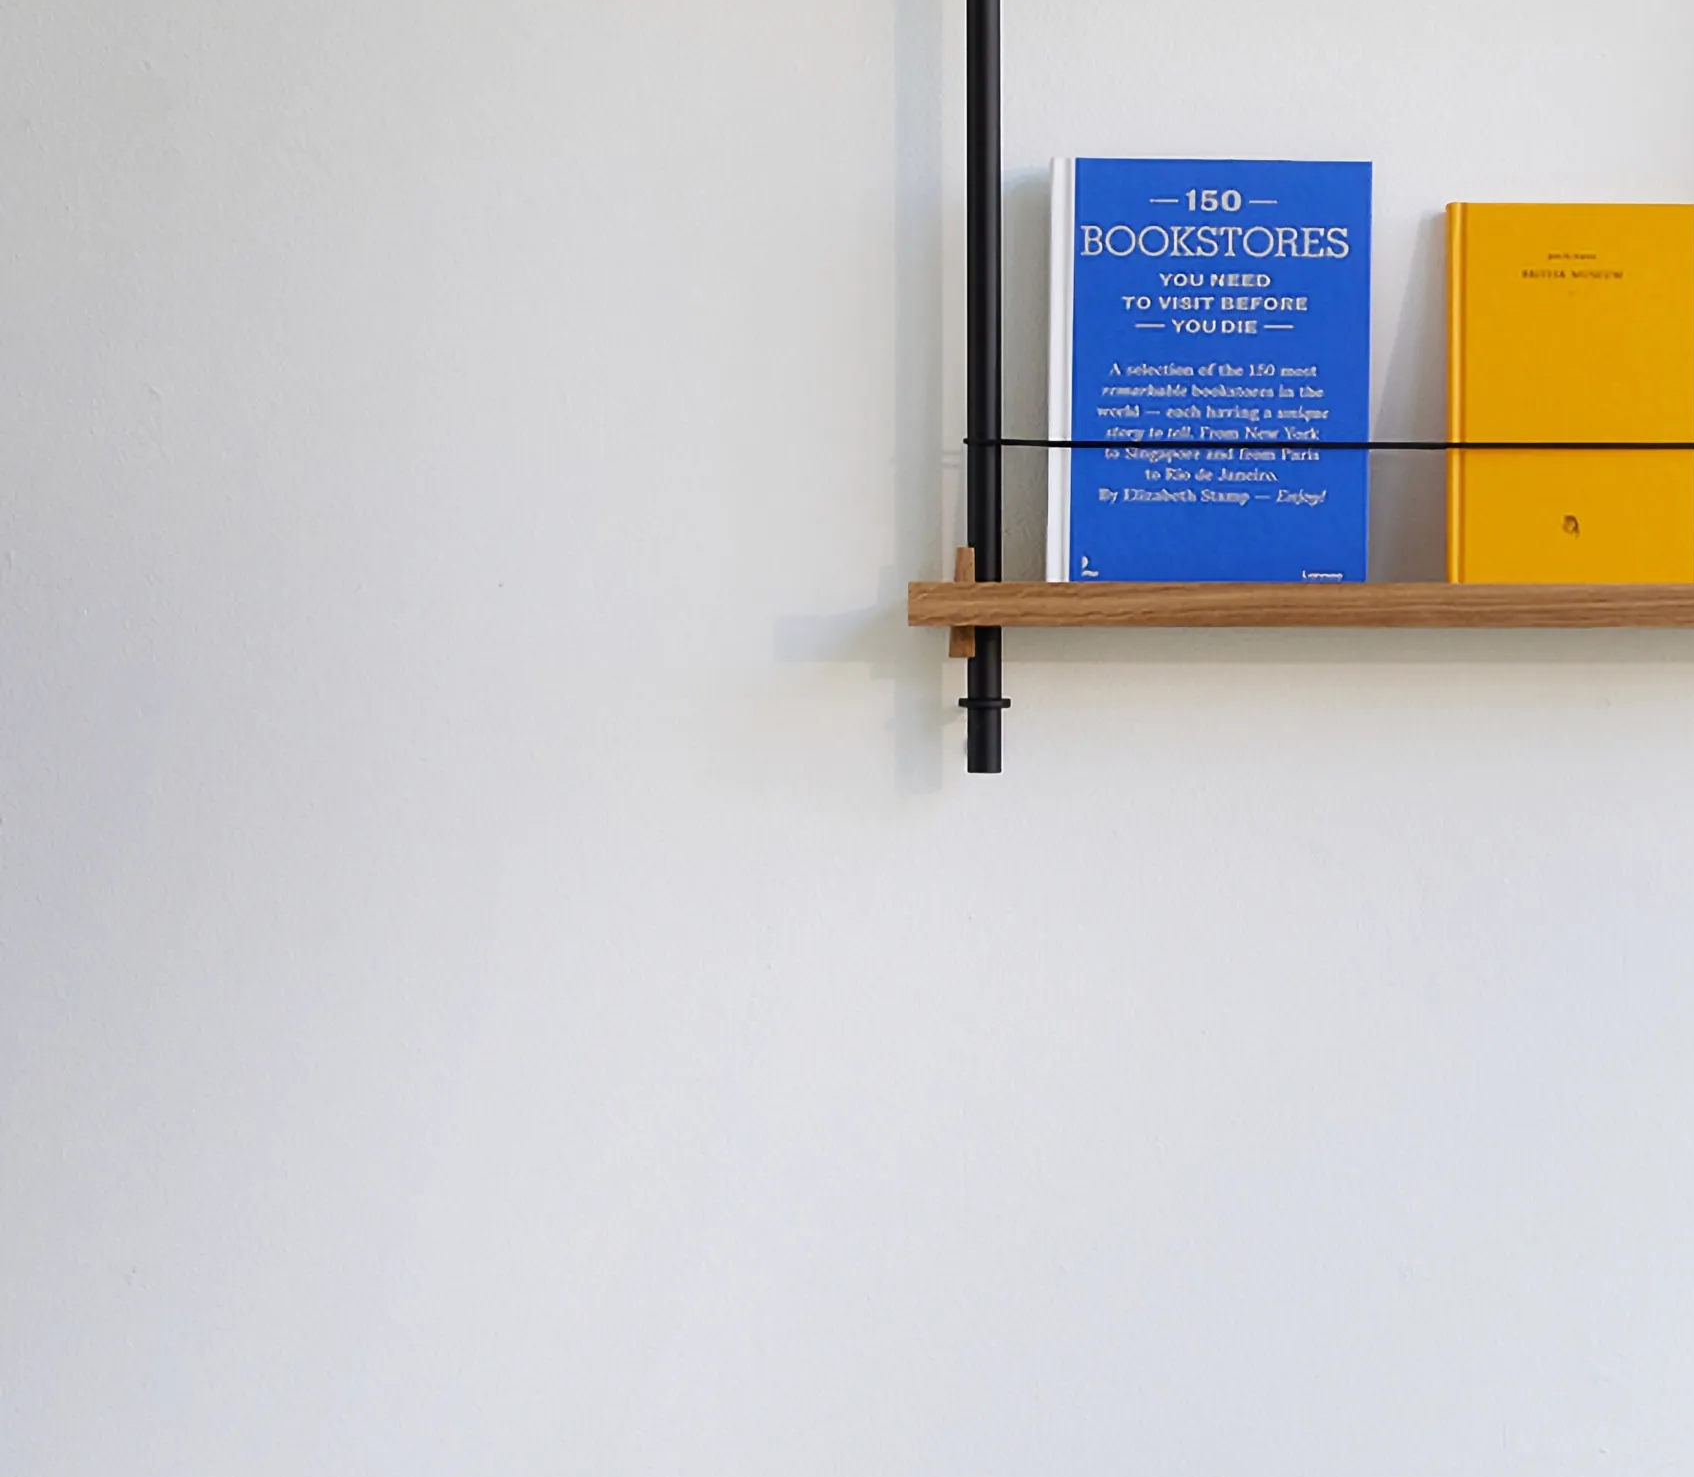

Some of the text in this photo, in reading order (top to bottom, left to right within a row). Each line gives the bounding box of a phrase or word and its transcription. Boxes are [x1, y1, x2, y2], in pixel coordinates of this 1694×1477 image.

[1184, 189, 1242, 212] 150
[1080, 225, 1350, 259] BOOKSTORES
[1159, 273, 1272, 288] YOU NEED
[1122, 295, 1309, 312] TO VISIT BEFORE
[1171, 319, 1258, 335] YOU DIE
[1109, 362, 1317, 377] A selection of the 150 most
[1102, 383, 1324, 398] remarkable bookstores in the
[1096, 404, 1140, 419] world
[1165, 405, 1202, 419] each
[1206, 405, 1260, 422] having
[1263, 408, 1273, 419] a
[1277, 405, 1330, 422] unique
[1105, 426, 1145, 442] story
[1148, 427, 1164, 438] to
[1200, 425, 1239, 440] From
[1244, 425, 1280, 440] New
[1283, 425, 1321, 441] York
[1104, 447, 1320, 463] to Singapore and from Paris
[1144, 468, 1161, 481] to
[1165, 467, 1192, 481] Rio
[1194, 467, 1214, 482] de
[1098, 488, 1119, 505] By
[1123, 488, 1197, 502] Elizabeth
[1200, 489, 1251, 506] Stamp
[1276, 488, 1328, 508] Enjoy!
